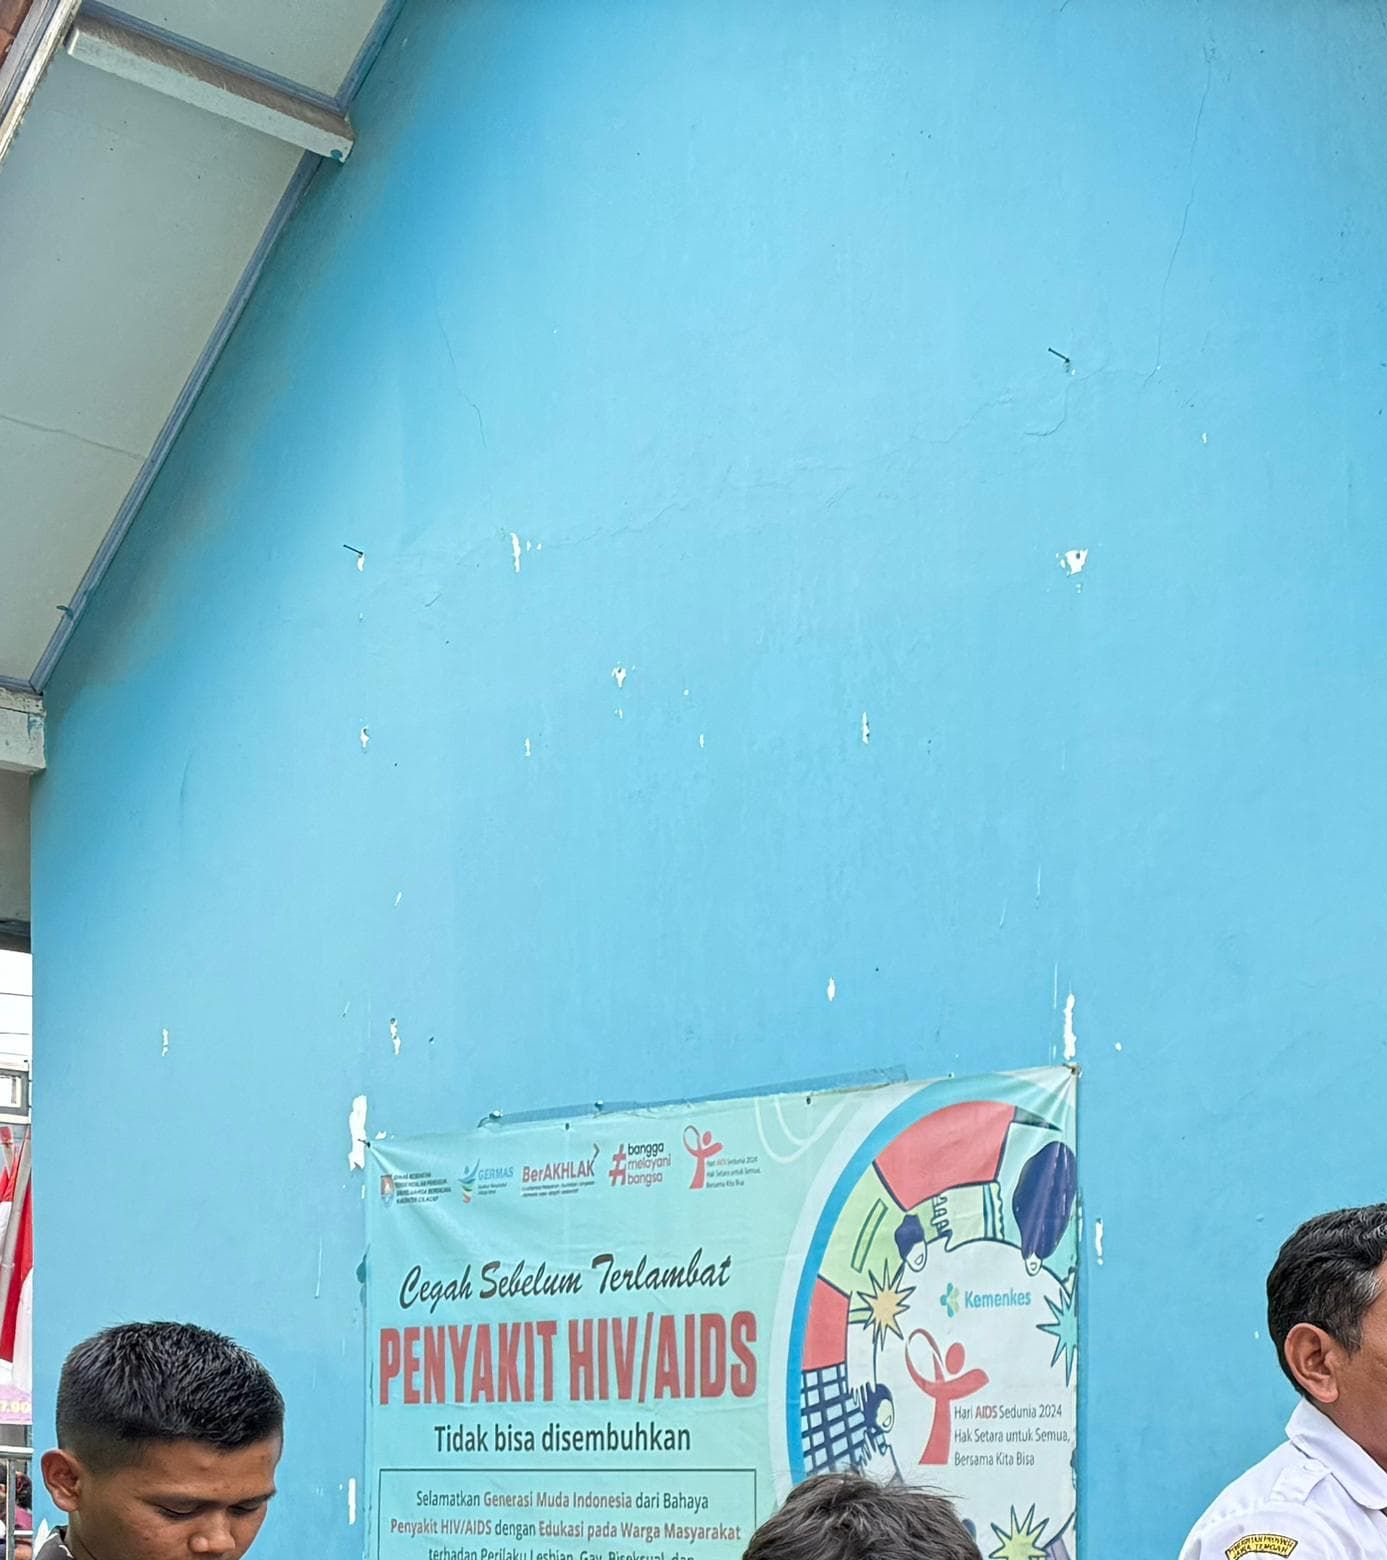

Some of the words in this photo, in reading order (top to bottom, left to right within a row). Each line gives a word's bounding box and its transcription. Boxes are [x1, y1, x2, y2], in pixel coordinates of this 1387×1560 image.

[627, 1142, 664, 1157] bangga
[522, 1158, 595, 1183] BerAKHLAK
[627, 1153, 671, 1171] melayani
[478, 1166, 514, 1181] GERMAS
[627, 1171, 663, 1187] bangsa
[400, 1264, 473, 1314] Cegah
[479, 1260, 583, 1300] Sebelum
[591, 1247, 732, 1296] Terlambat
[964, 1287, 1032, 1308] Kemenkes
[379, 1320, 558, 1406] PENYAKIT
[568, 1311, 758, 1403] HIV/AIDS
[954, 1406, 973, 1420] Hari
[975, 1405, 998, 1419] AIDS
[999, 1404, 1037, 1419] Sedunia
[1039, 1404, 1062, 1417] 2024
[435, 1423, 488, 1453] Tidak
[495, 1423, 535, 1451] bisa
[541, 1421, 691, 1452] disembuhkan
[954, 1429, 972, 1443] Hak
[974, 1429, 1004, 1443] Setara
[1006, 1429, 1033, 1443] untuk
[1035, 1428, 1071, 1443] Semua,
[954, 1453, 993, 1466] Bersama
[995, 1453, 1014, 1466] Kita
[1016, 1452, 1035, 1466] Bisa
[416, 1489, 480, 1508] Selamatkan
[483, 1491, 533, 1508] Generasi
[536, 1491, 570, 1508] Muda
[573, 1491, 633, 1509] Indonesia
[635, 1491, 661, 1510] dari
[663, 1492, 709, 1514] Bahaya
[390, 1519, 438, 1538] Penyakit
[441, 1520, 492, 1537] HIV/AIDS
[494, 1520, 537, 1541] dengan
[538, 1520, 584, 1539] Edukasi
[587, 1521, 618, 1542] pada
[620, 1522, 661, 1543] Warga
[664, 1523, 741, 1544] Masyarakat
